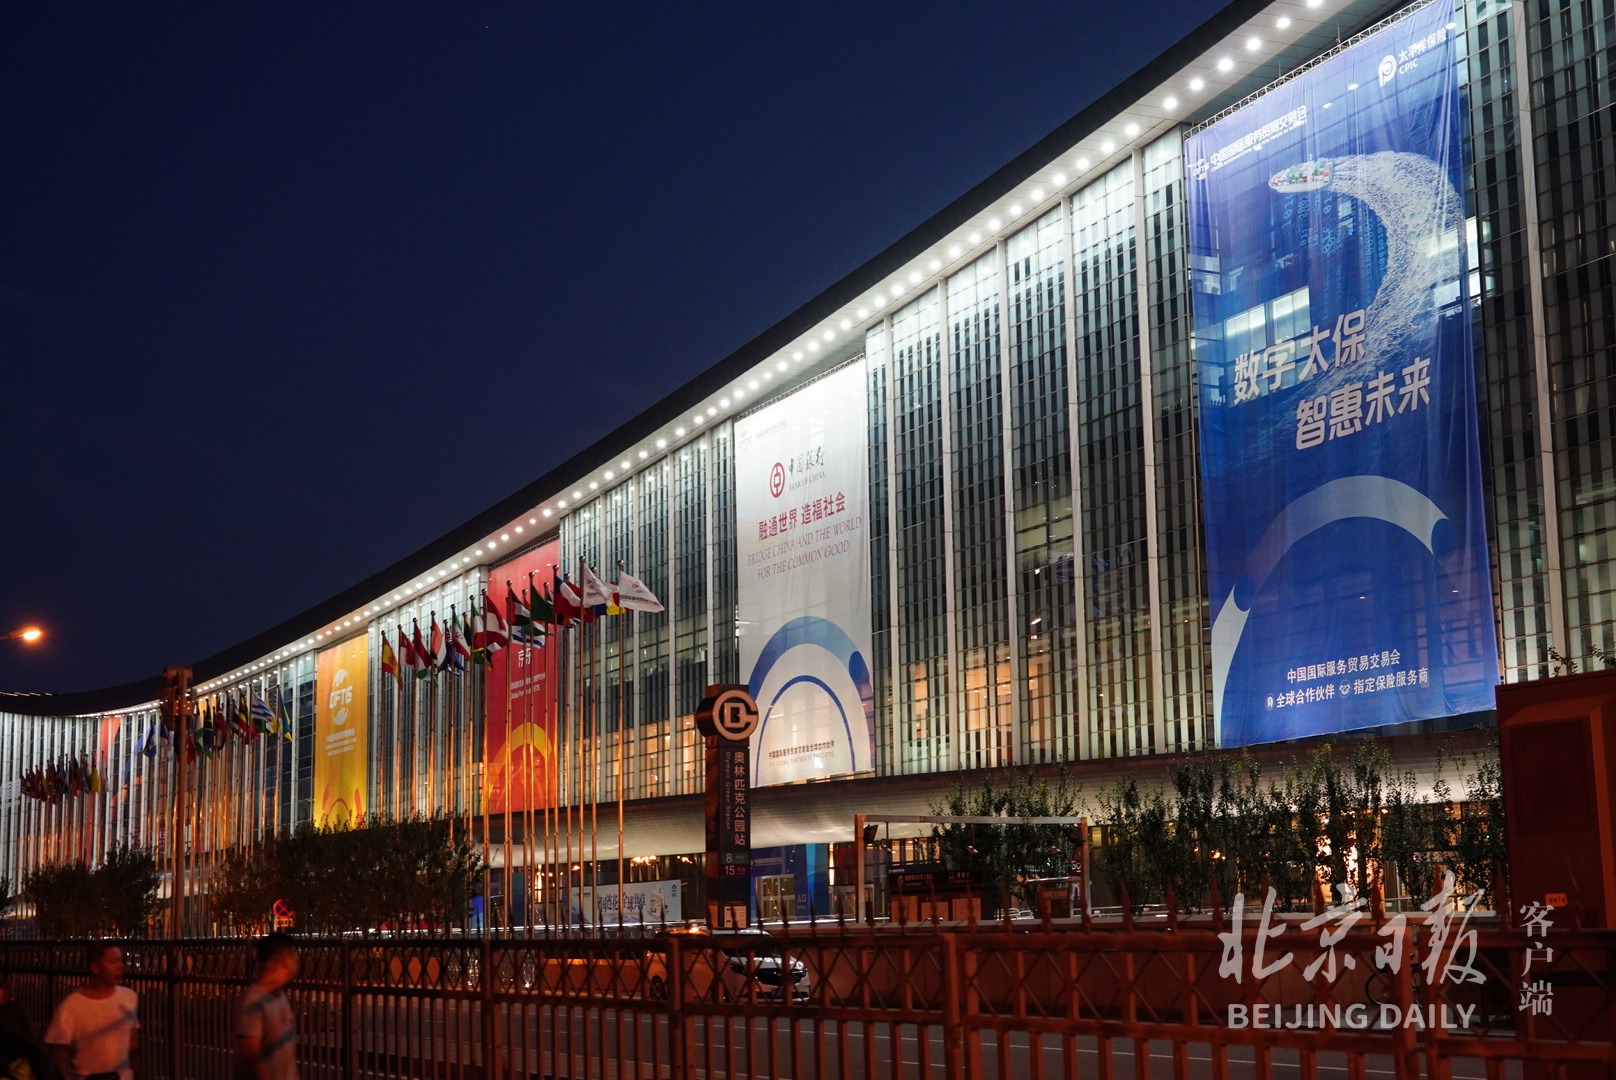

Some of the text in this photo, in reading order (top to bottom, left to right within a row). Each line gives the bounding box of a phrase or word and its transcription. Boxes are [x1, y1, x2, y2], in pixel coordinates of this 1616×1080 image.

[1399, 58, 1418, 75] CPIC
[1234, 308, 1366, 405] 数字太保
[1296, 357, 1431, 450] 智惠未来
[788, 446, 825, 478] 中国银行
[808, 471, 826, 483] CHINA
[758, 491, 846, 542] 融通世界 造福社会
[747, 515, 863, 567] BRIDGE CHINA AND THE WORLD
[757, 538, 850, 581] FOR THE COMMON GOOD
[1287, 648, 1401, 685] 中国国际服务贸易交易会
[1276, 667, 1429, 708] 全球合作伙伴 指定保险服务商
[734, 751, 746, 846] 奥林匹克公园站
[724, 865, 735, 876] 15
[725, 852, 733, 864] 8
